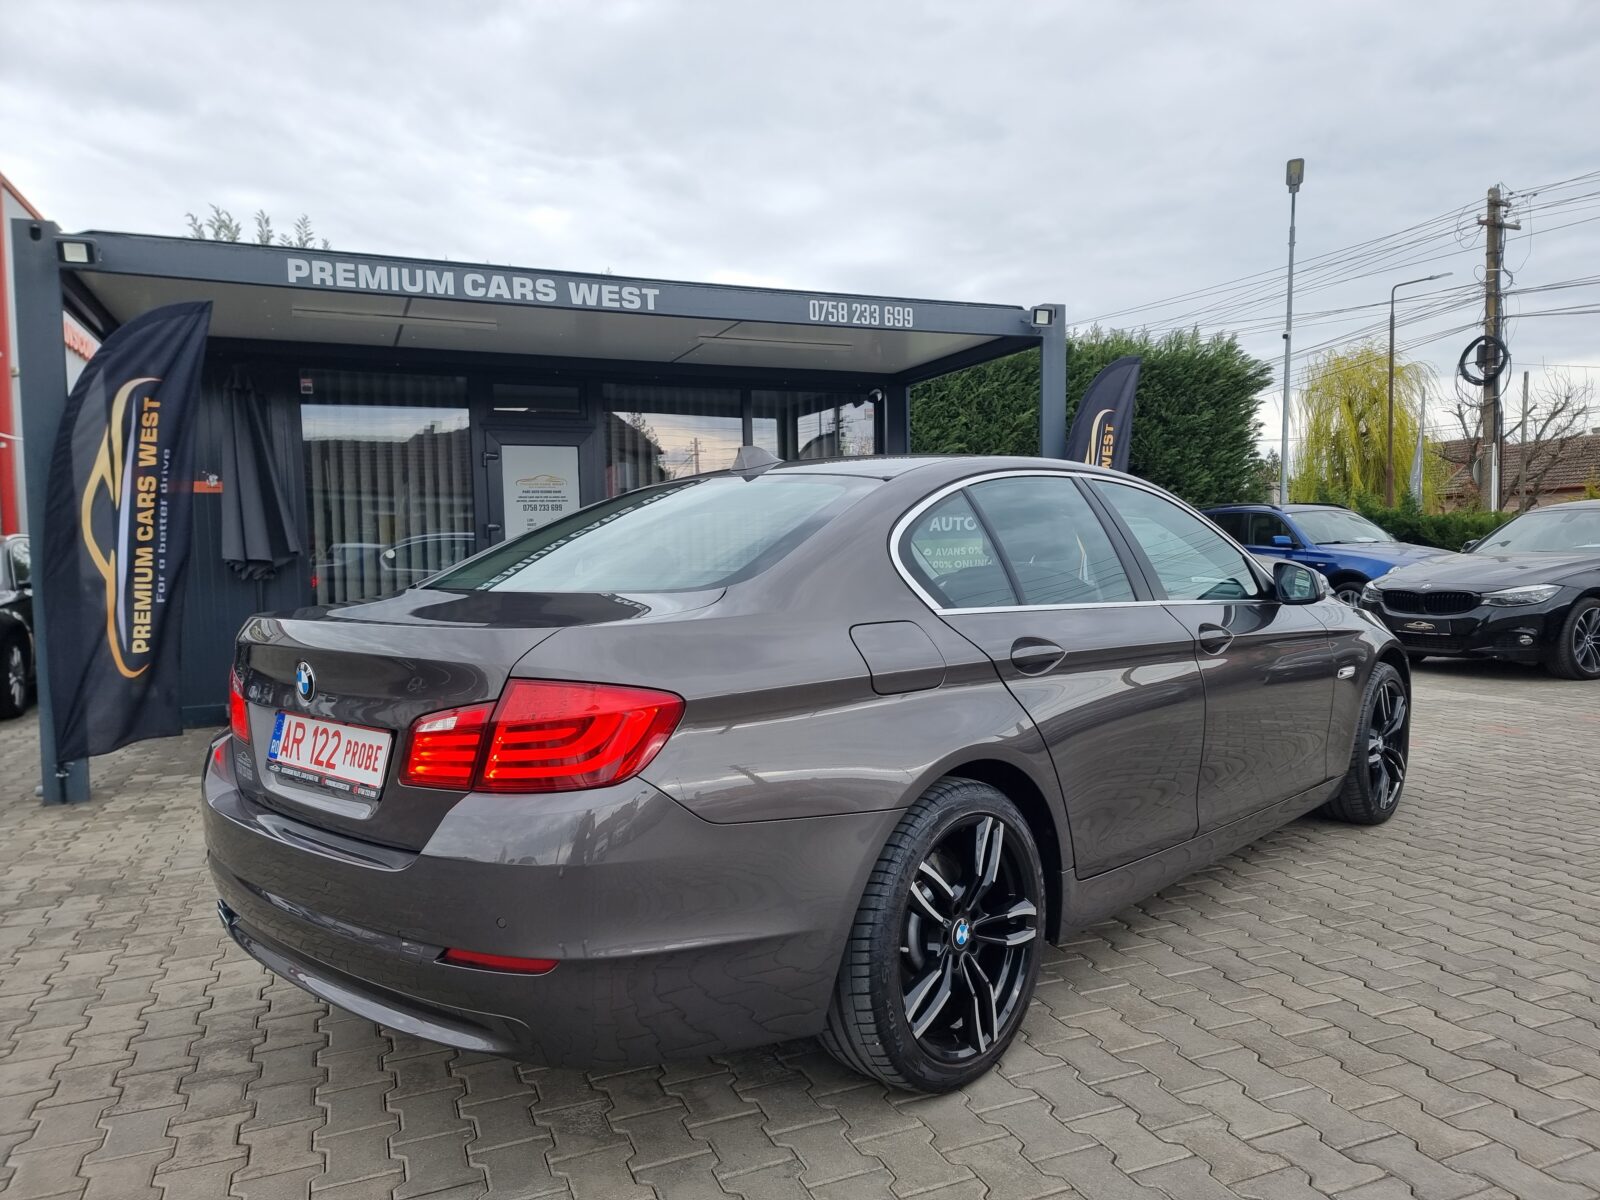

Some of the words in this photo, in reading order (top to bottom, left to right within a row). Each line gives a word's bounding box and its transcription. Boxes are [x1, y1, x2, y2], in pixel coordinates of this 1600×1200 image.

[287, 258, 455, 296] PREMIUM
[463, 273, 557, 302] CARS
[568, 281, 660, 311] WEST
[809, 300, 848, 323] 0758
[852, 303, 880, 325] 233
[884, 306, 913, 328] 699
[138, 396, 161, 467] WEST
[1101, 423, 1114, 469] WEST
[160, 448, 171, 494] drive
[136, 475, 157, 541] CARS
[158, 498, 168, 553] better
[522, 504, 538, 512] 0758
[539, 504, 550, 512] 233
[551, 504, 563, 512] 699
[929, 516, 977, 532] AUTO
[159, 559, 166, 569] a
[932, 560, 953, 569] 00%
[936, 547, 967, 556] AVANS
[132, 547, 153, 654] PREMIUM
[156, 574, 166, 603] For
[270, 739, 280, 754] RO
[280, 720, 306, 761] AR
[309, 726, 342, 770] 122
[343, 739, 383, 773] PROBE
